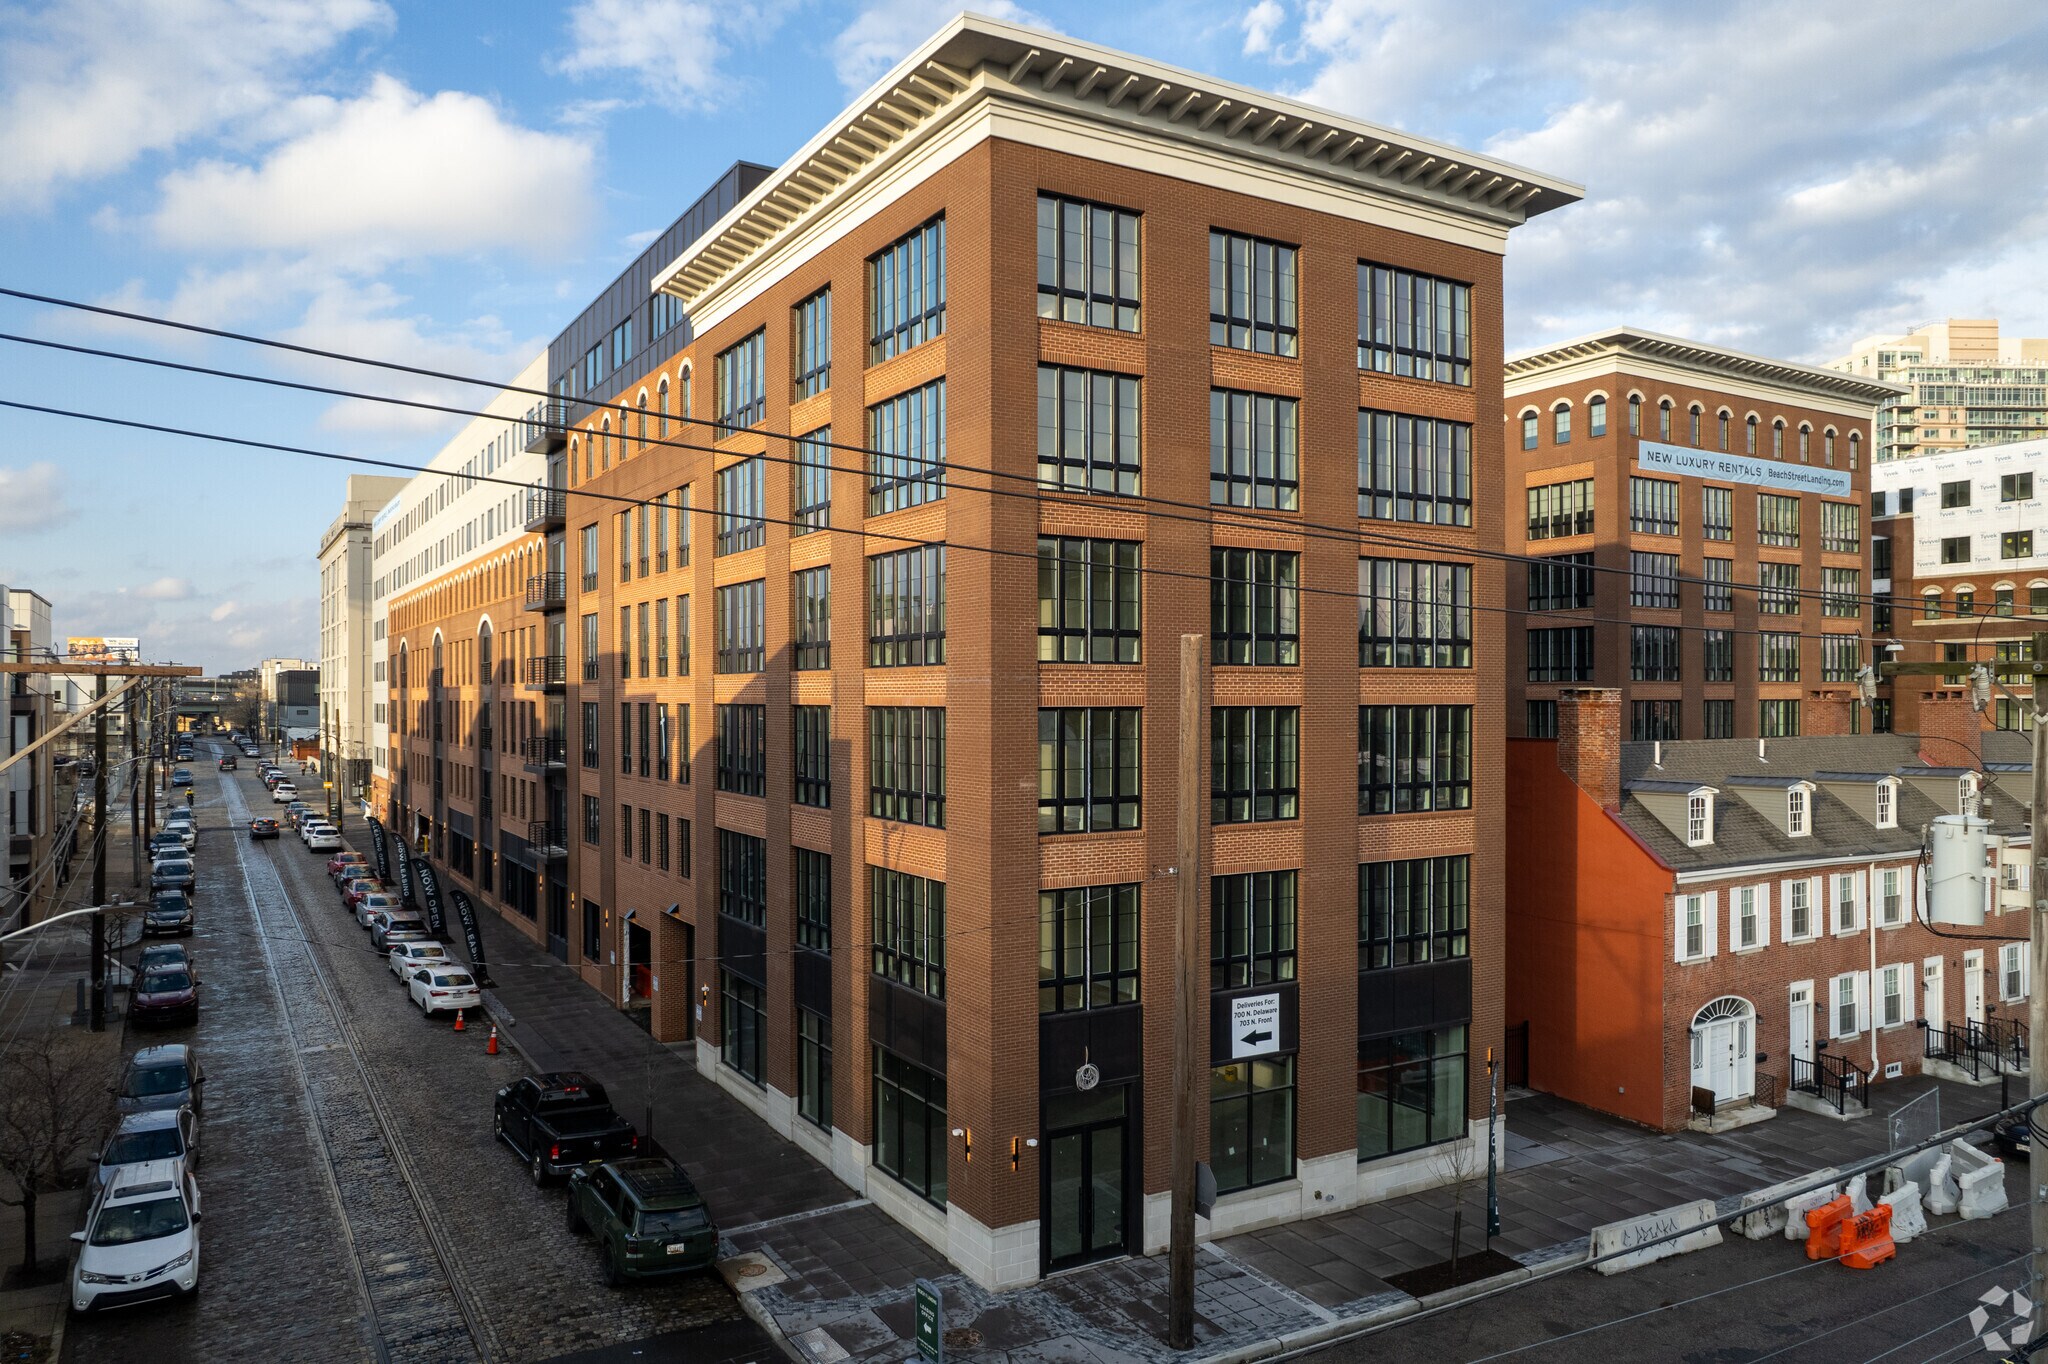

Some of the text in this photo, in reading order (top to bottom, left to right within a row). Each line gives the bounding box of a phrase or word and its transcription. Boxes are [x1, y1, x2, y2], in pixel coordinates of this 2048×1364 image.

[1647, 450, 1845, 488] NEW LUXURY RENTALS BeachStreetLanding.com
[397, 842, 405, 861] NOW
[400, 864, 410, 897] LEASING
[419, 869, 435, 896] NOW
[428, 899, 441, 929] OPEN
[458, 901, 471, 925] NOW
[1237, 1000, 1263, 1009] Deliveries
[1240, 1019, 1250, 1027] 703
